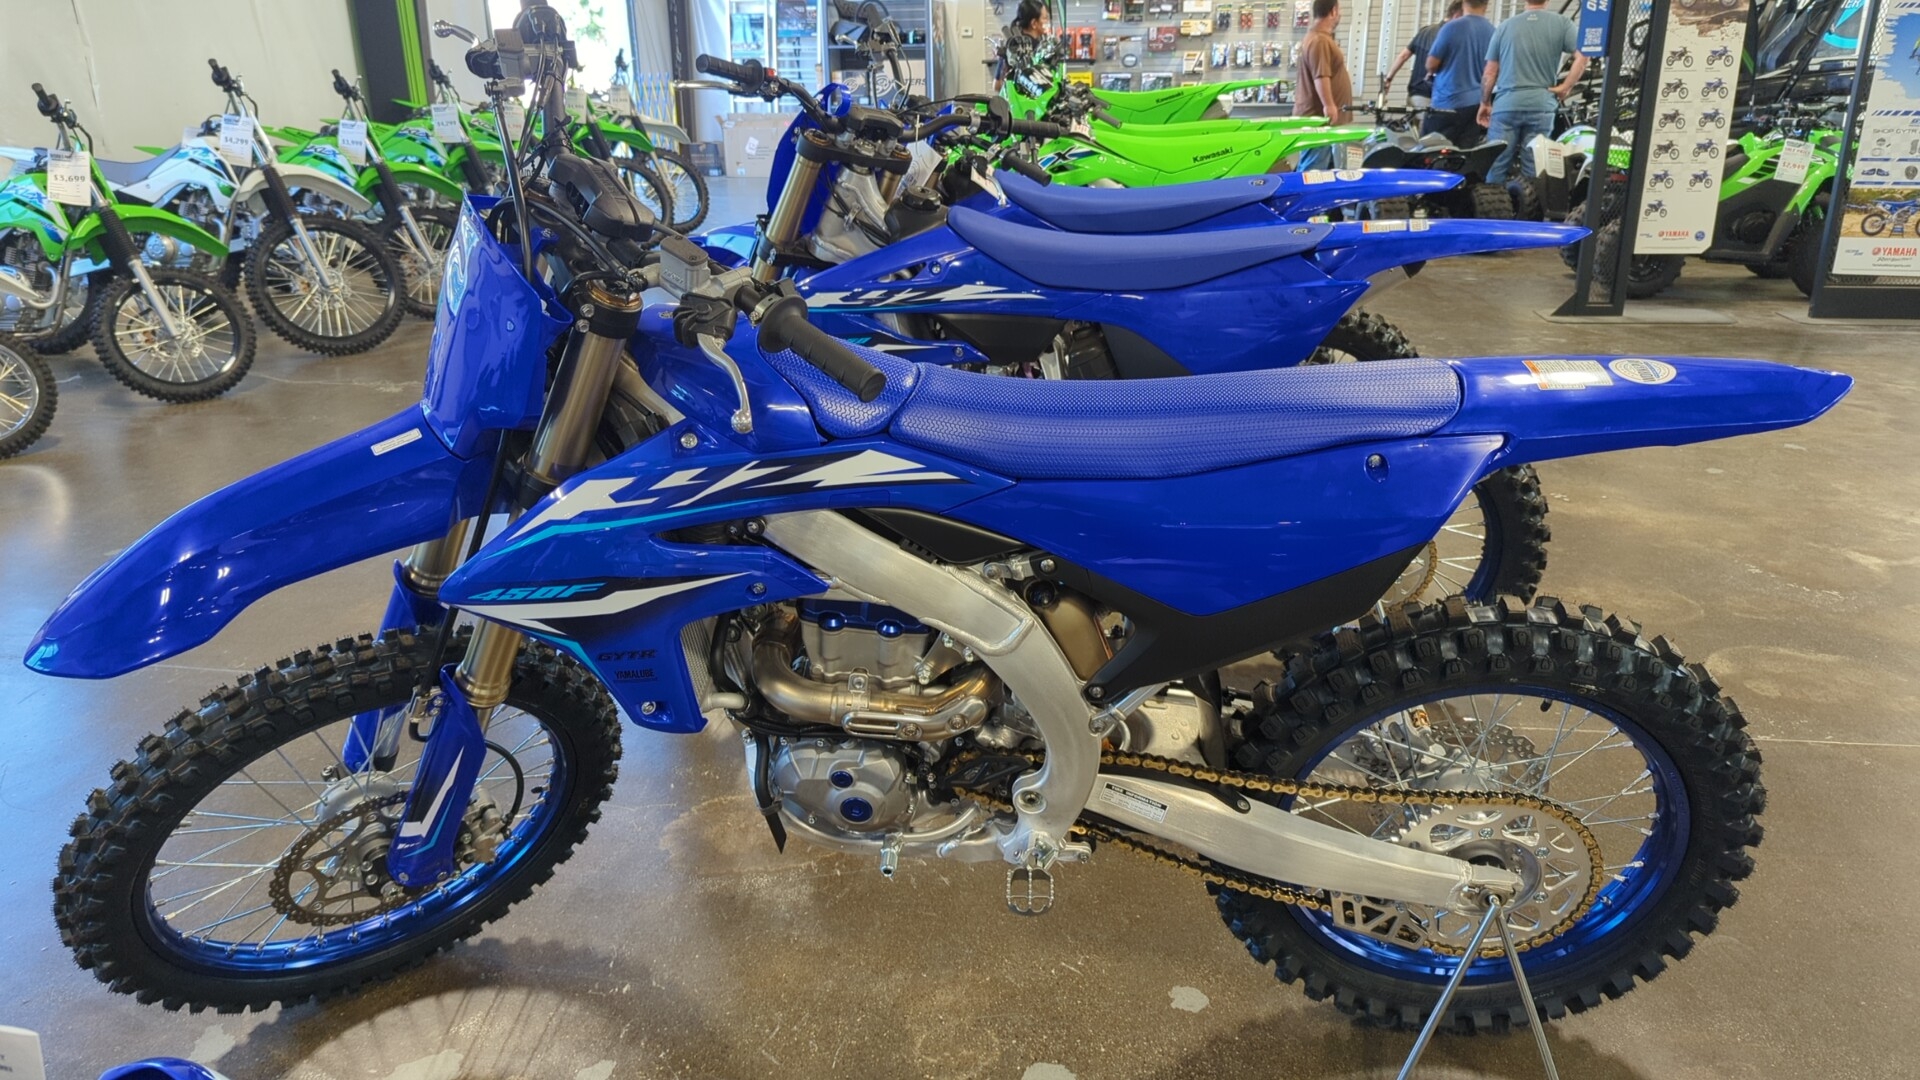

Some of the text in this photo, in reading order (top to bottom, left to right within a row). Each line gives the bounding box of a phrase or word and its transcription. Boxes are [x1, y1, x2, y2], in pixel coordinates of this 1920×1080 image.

[1192, 146, 1234, 164] Kawasaki
[1882, 247, 1917, 257] YAMAHA
[467, 582, 608, 601] 450F
[598, 649, 657, 661] GYTR
[614, 669, 655, 679] YAMALUBE
